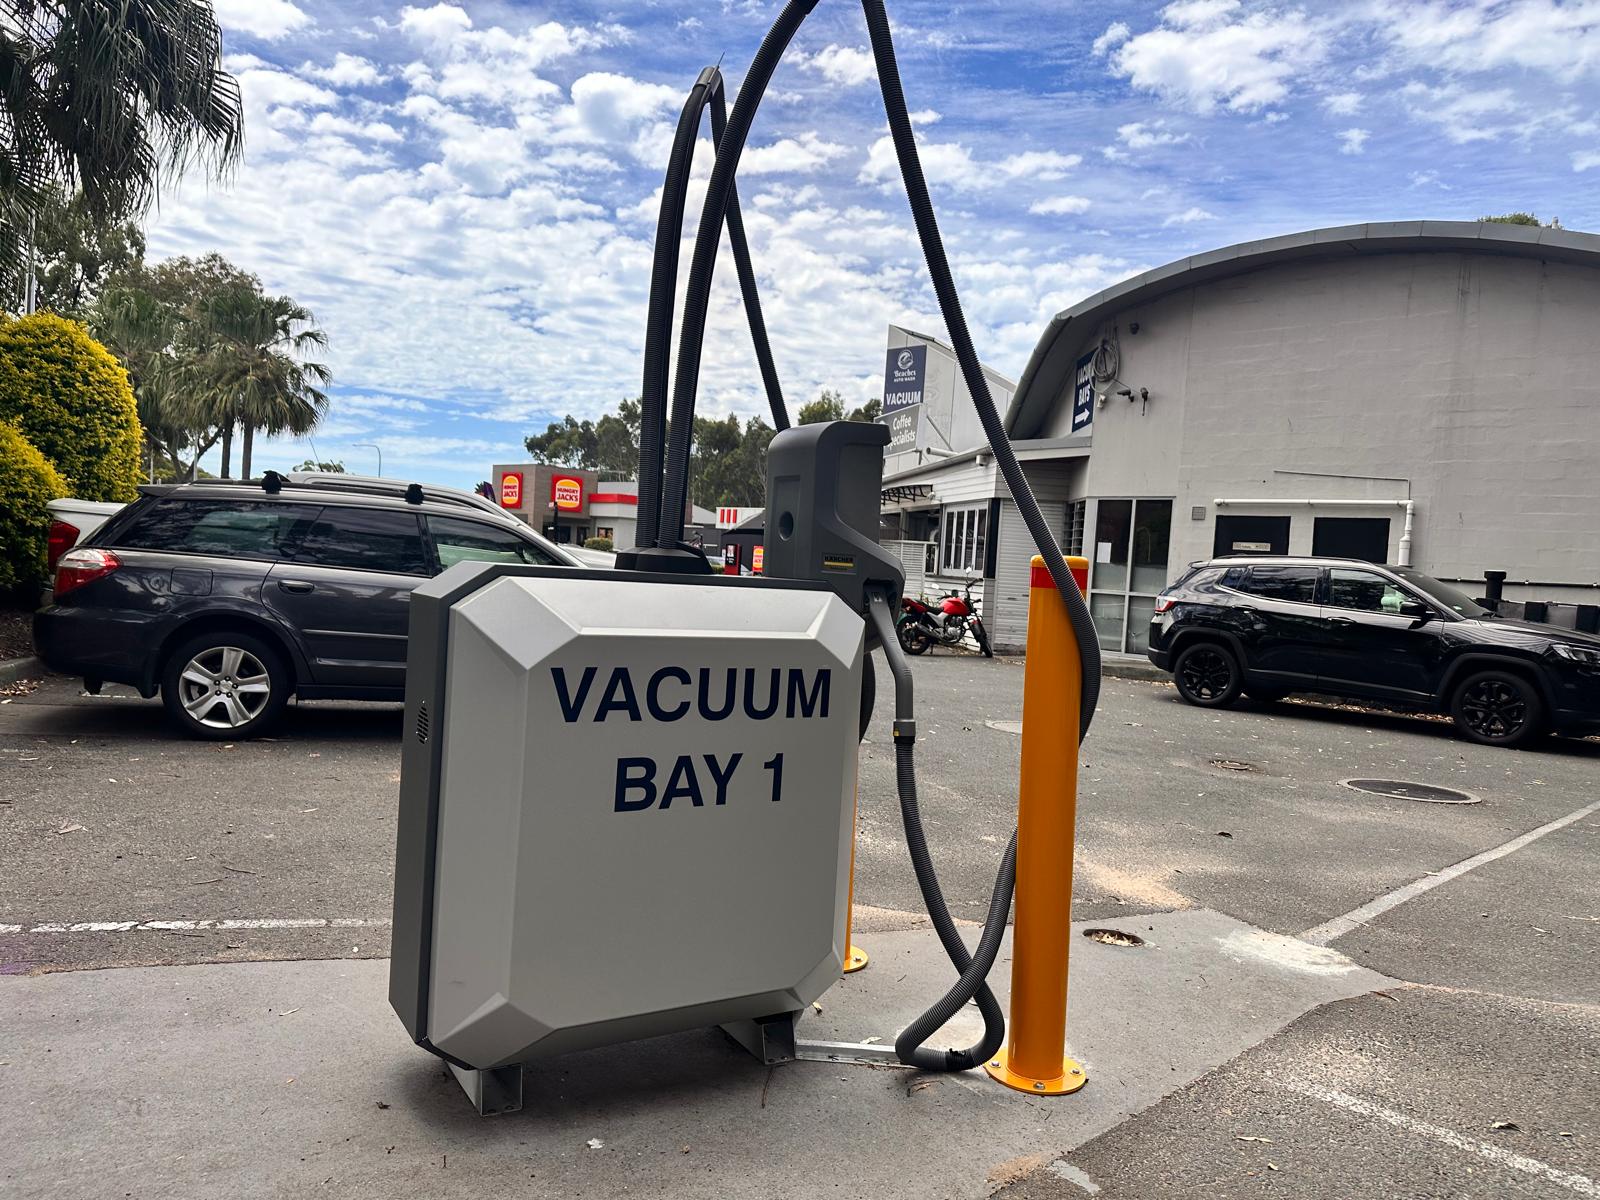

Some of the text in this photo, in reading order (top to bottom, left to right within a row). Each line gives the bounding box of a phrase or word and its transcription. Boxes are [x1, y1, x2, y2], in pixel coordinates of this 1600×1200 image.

[886, 390, 921, 405] VACUUM
[893, 414, 912, 430] Coffee
[888, 430, 916, 450] pecialists
[557, 493, 579, 502] JACK'S
[551, 666, 831, 722] VACUUM
[614, 753, 784, 812] BAY 1
